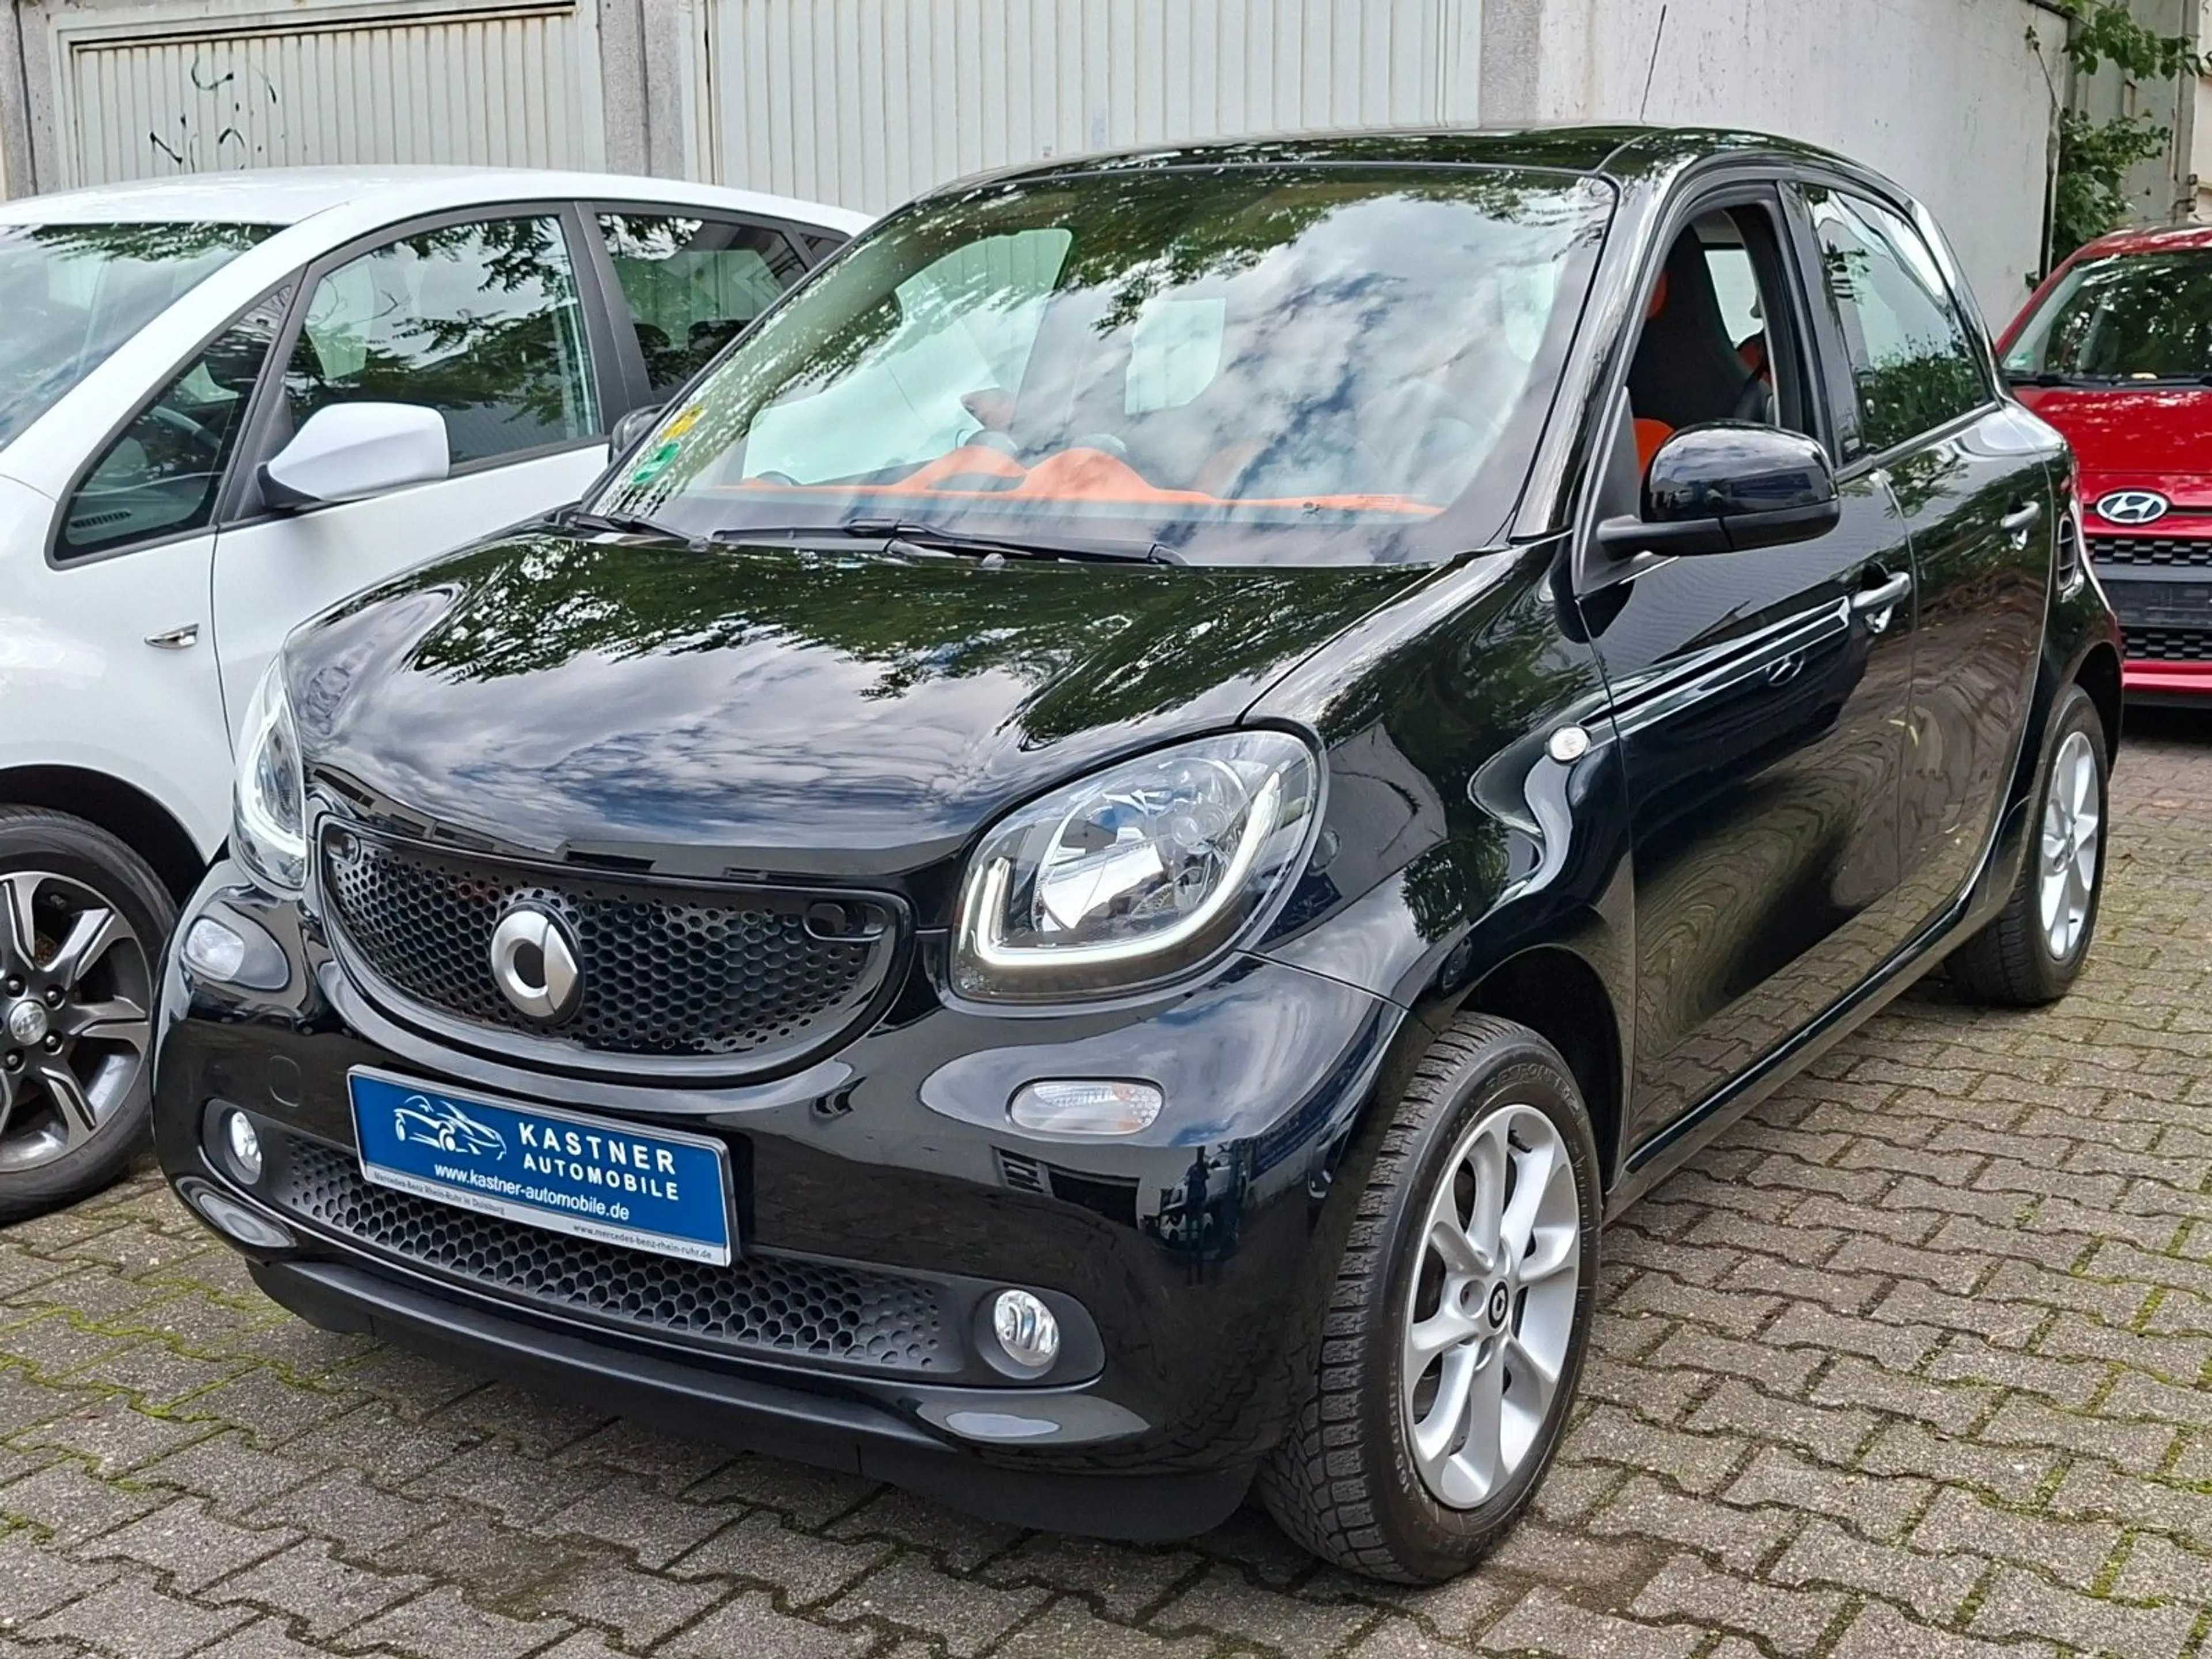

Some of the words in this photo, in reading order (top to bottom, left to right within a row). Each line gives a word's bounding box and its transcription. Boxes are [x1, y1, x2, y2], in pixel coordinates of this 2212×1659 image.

[519, 1122, 676, 1175] KASTNER
[434, 1164, 630, 1221] www.kastner-automobile.de
[523, 1153, 679, 1200] AUTOMOBILE
[573, 1224, 713, 1259] www.mercedes-benz-rhein-ruhr.de
